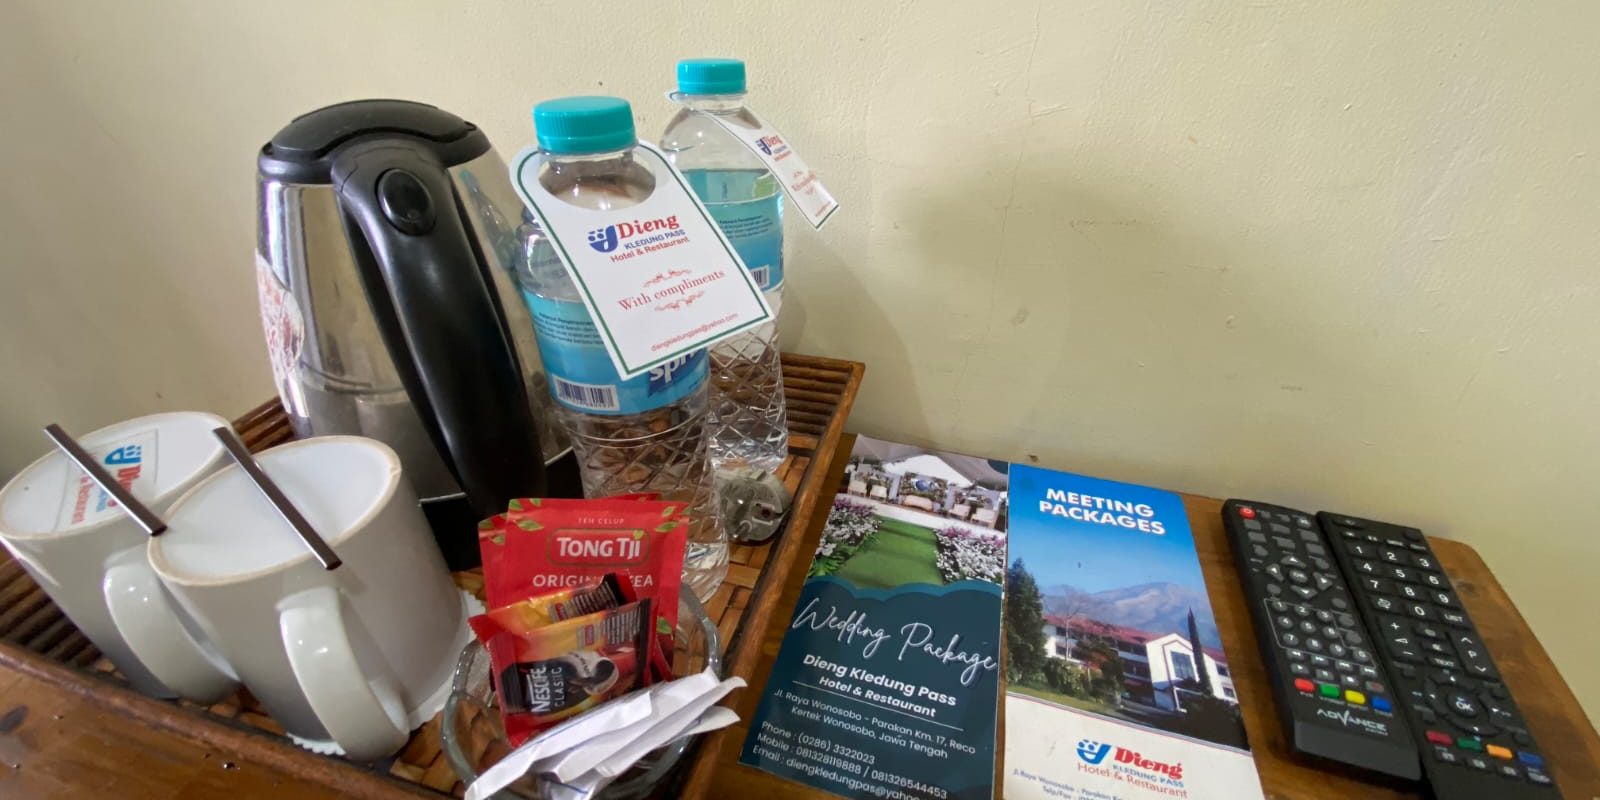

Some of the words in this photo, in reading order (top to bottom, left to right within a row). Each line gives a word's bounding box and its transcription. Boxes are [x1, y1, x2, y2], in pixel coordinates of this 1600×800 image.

[616, 215, 679, 239] Dieng
[624, 234, 664, 250] KLEDUNG
[665, 229, 686, 240] PASS
[610, 250, 635, 263] Hotel
[636, 248, 644, 256] &
[644, 236, 690, 253] Restaurant
[617, 292, 652, 311] With
[654, 270, 726, 301] compliments
[1046, 487, 1154, 518] MEETING
[1039, 500, 1166, 535] PACKAGES
[556, 537, 613, 557] TONG
[1355, 546, 1363, 554] 1
[1387, 552, 1397, 561] 2
[1419, 558, 1430, 567] 3
[532, 574, 605, 588] ORIGI
[629, 574, 653, 588] EA
[1363, 563, 1372, 571] 4
[1395, 569, 1405, 578] 5
[1429, 575, 1439, 585] 6
[1370, 579, 1379, 589] 7
[1404, 586, 1415, 597] 8
[1438, 593, 1449, 604] 9
[1414, 605, 1425, 616] 0
[792, 597, 892, 660] Wedding
[898, 622, 998, 686] Package
[803, 654, 848, 679] Dieng
[849, 666, 916, 697] Kledung
[918, 687, 958, 707] Pass
[818, 676, 852, 693] Hotel
[852, 686, 862, 697] &
[864, 689, 937, 718] Restaurant
[1455, 701, 1474, 712] OK
[785, 691, 810, 706] Raya
[811, 698, 862, 721] Wonosobo
[871, 717, 913, 736] Parakan
[949, 739, 976, 754] Reco
[791, 706, 822, 722] Kertek
[823, 715, 876, 739] Wonosobo,
[878, 732, 907, 747] Jawa
[909, 740, 948, 759] Tengah
[1317, 708, 1387, 732] ADVANCE
[753, 745, 781, 762] Email
[757, 733, 790, 751] Mobile
[761, 721, 792, 739] Phone
[798, 732, 831, 751] (0286)
[833, 744, 876, 765] 3322023
[1114, 746, 1183, 780] Dieng
[1077, 762, 1110, 777] Hotel
[1126, 774, 1188, 798] Restaurant
[1112, 764, 1157, 782] KLEDUNG
[1159, 776, 1185, 789] PASS
